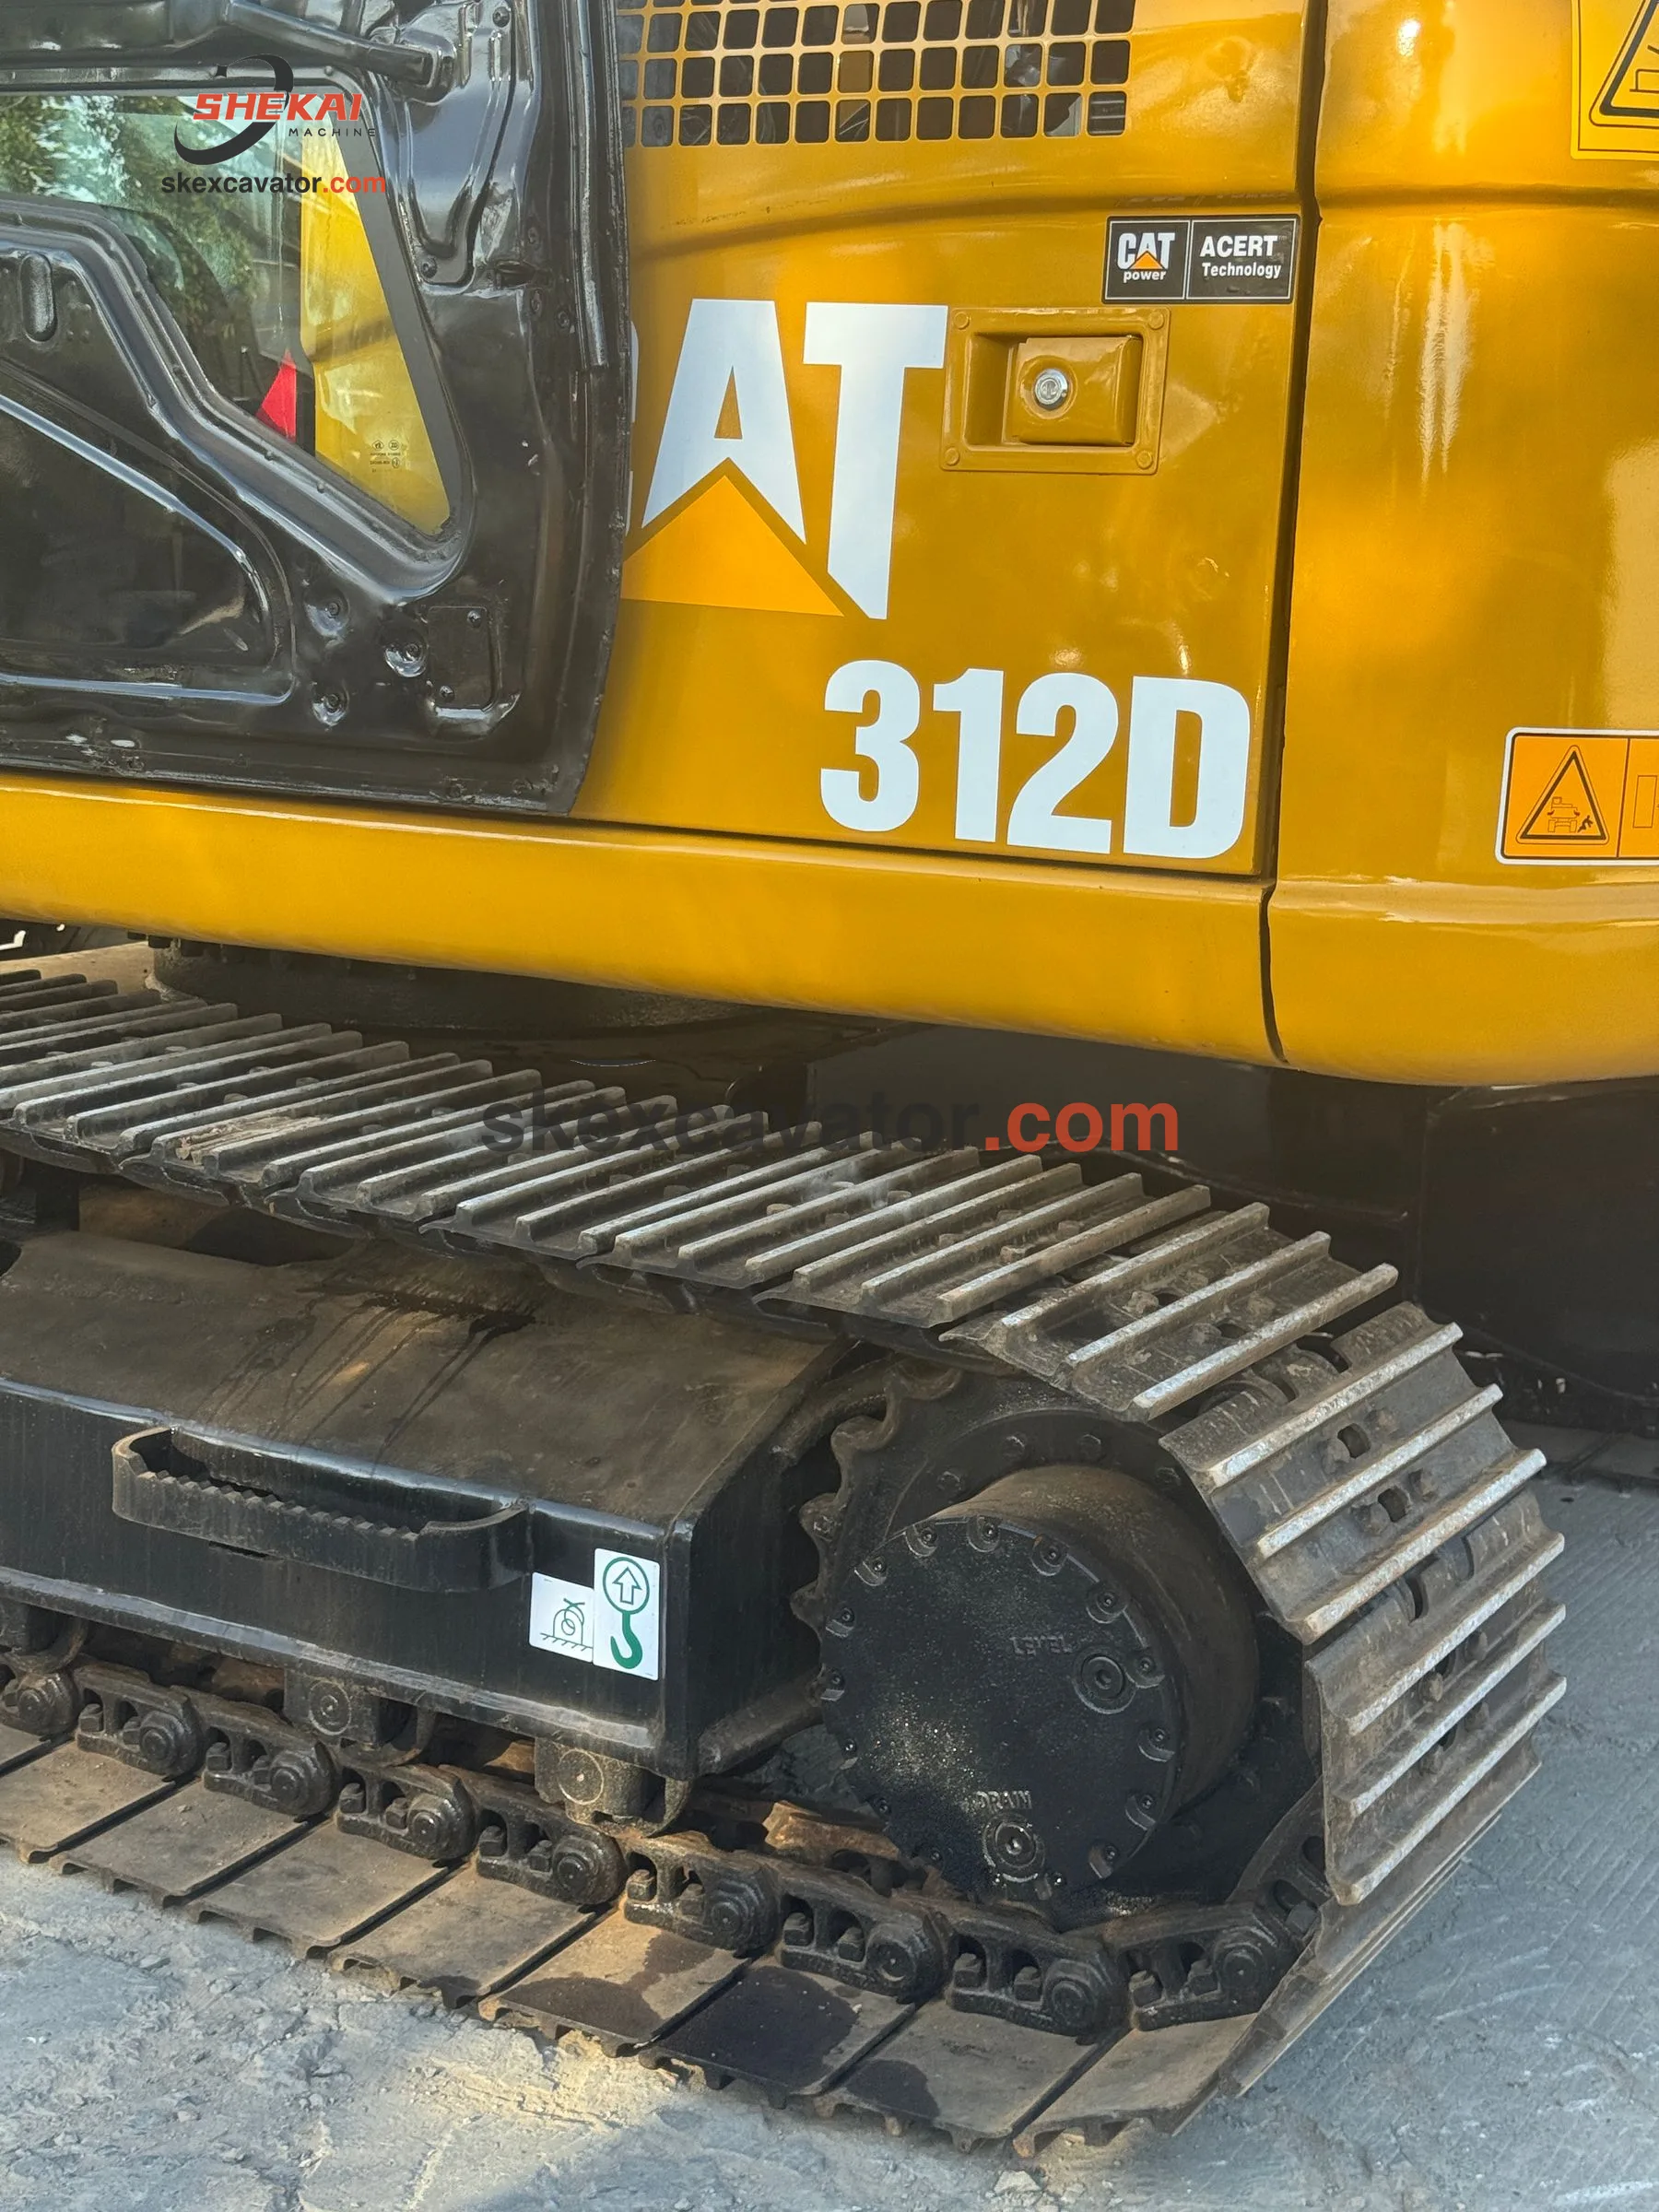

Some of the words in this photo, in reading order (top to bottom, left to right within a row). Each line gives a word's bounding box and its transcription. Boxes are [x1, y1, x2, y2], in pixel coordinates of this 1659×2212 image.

[1117, 232, 1175, 270] CAT
[1200, 235, 1278, 257] ACERT
[1124, 269, 1167, 283] power
[1202, 262, 1282, 278] Technology
[627, 298, 948, 620] AT
[820, 659, 1251, 859] 312D
